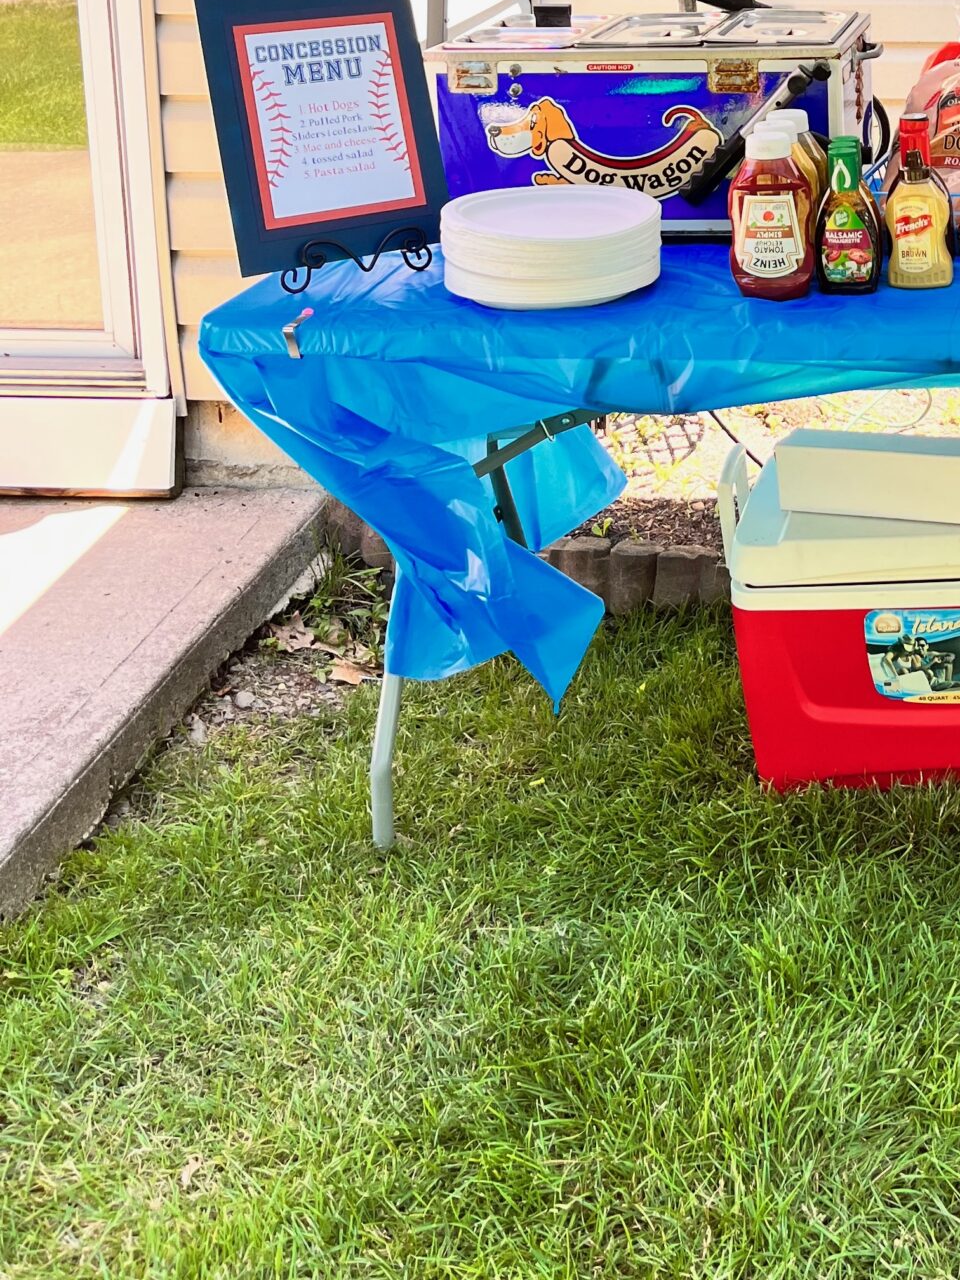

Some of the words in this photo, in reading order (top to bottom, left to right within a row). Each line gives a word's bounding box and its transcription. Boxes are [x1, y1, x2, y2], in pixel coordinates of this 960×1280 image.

[254, 34, 381, 63] CONCESSION
[282, 56, 362, 86] MENU
[308, 102, 329, 114] Hot
[332, 99, 360, 111] Dogs
[309, 114, 341, 127] Pulled
[341, 112, 363, 123] Pork
[303, 143, 322, 153] Mac
[324, 139, 342, 150] and
[344, 137, 377, 147] cheese
[312, 152, 344, 165] tossed
[345, 148, 374, 159] salad
[314, 167, 344, 178] Pasta
[346, 161, 376, 173] salad
[562, 151, 618, 187] Dog
[620, 145, 708, 193] Wagon
[896, 217, 930, 235] French's
[901, 249, 927, 259] BROWN
[752, 257, 786, 269] HEINZ
